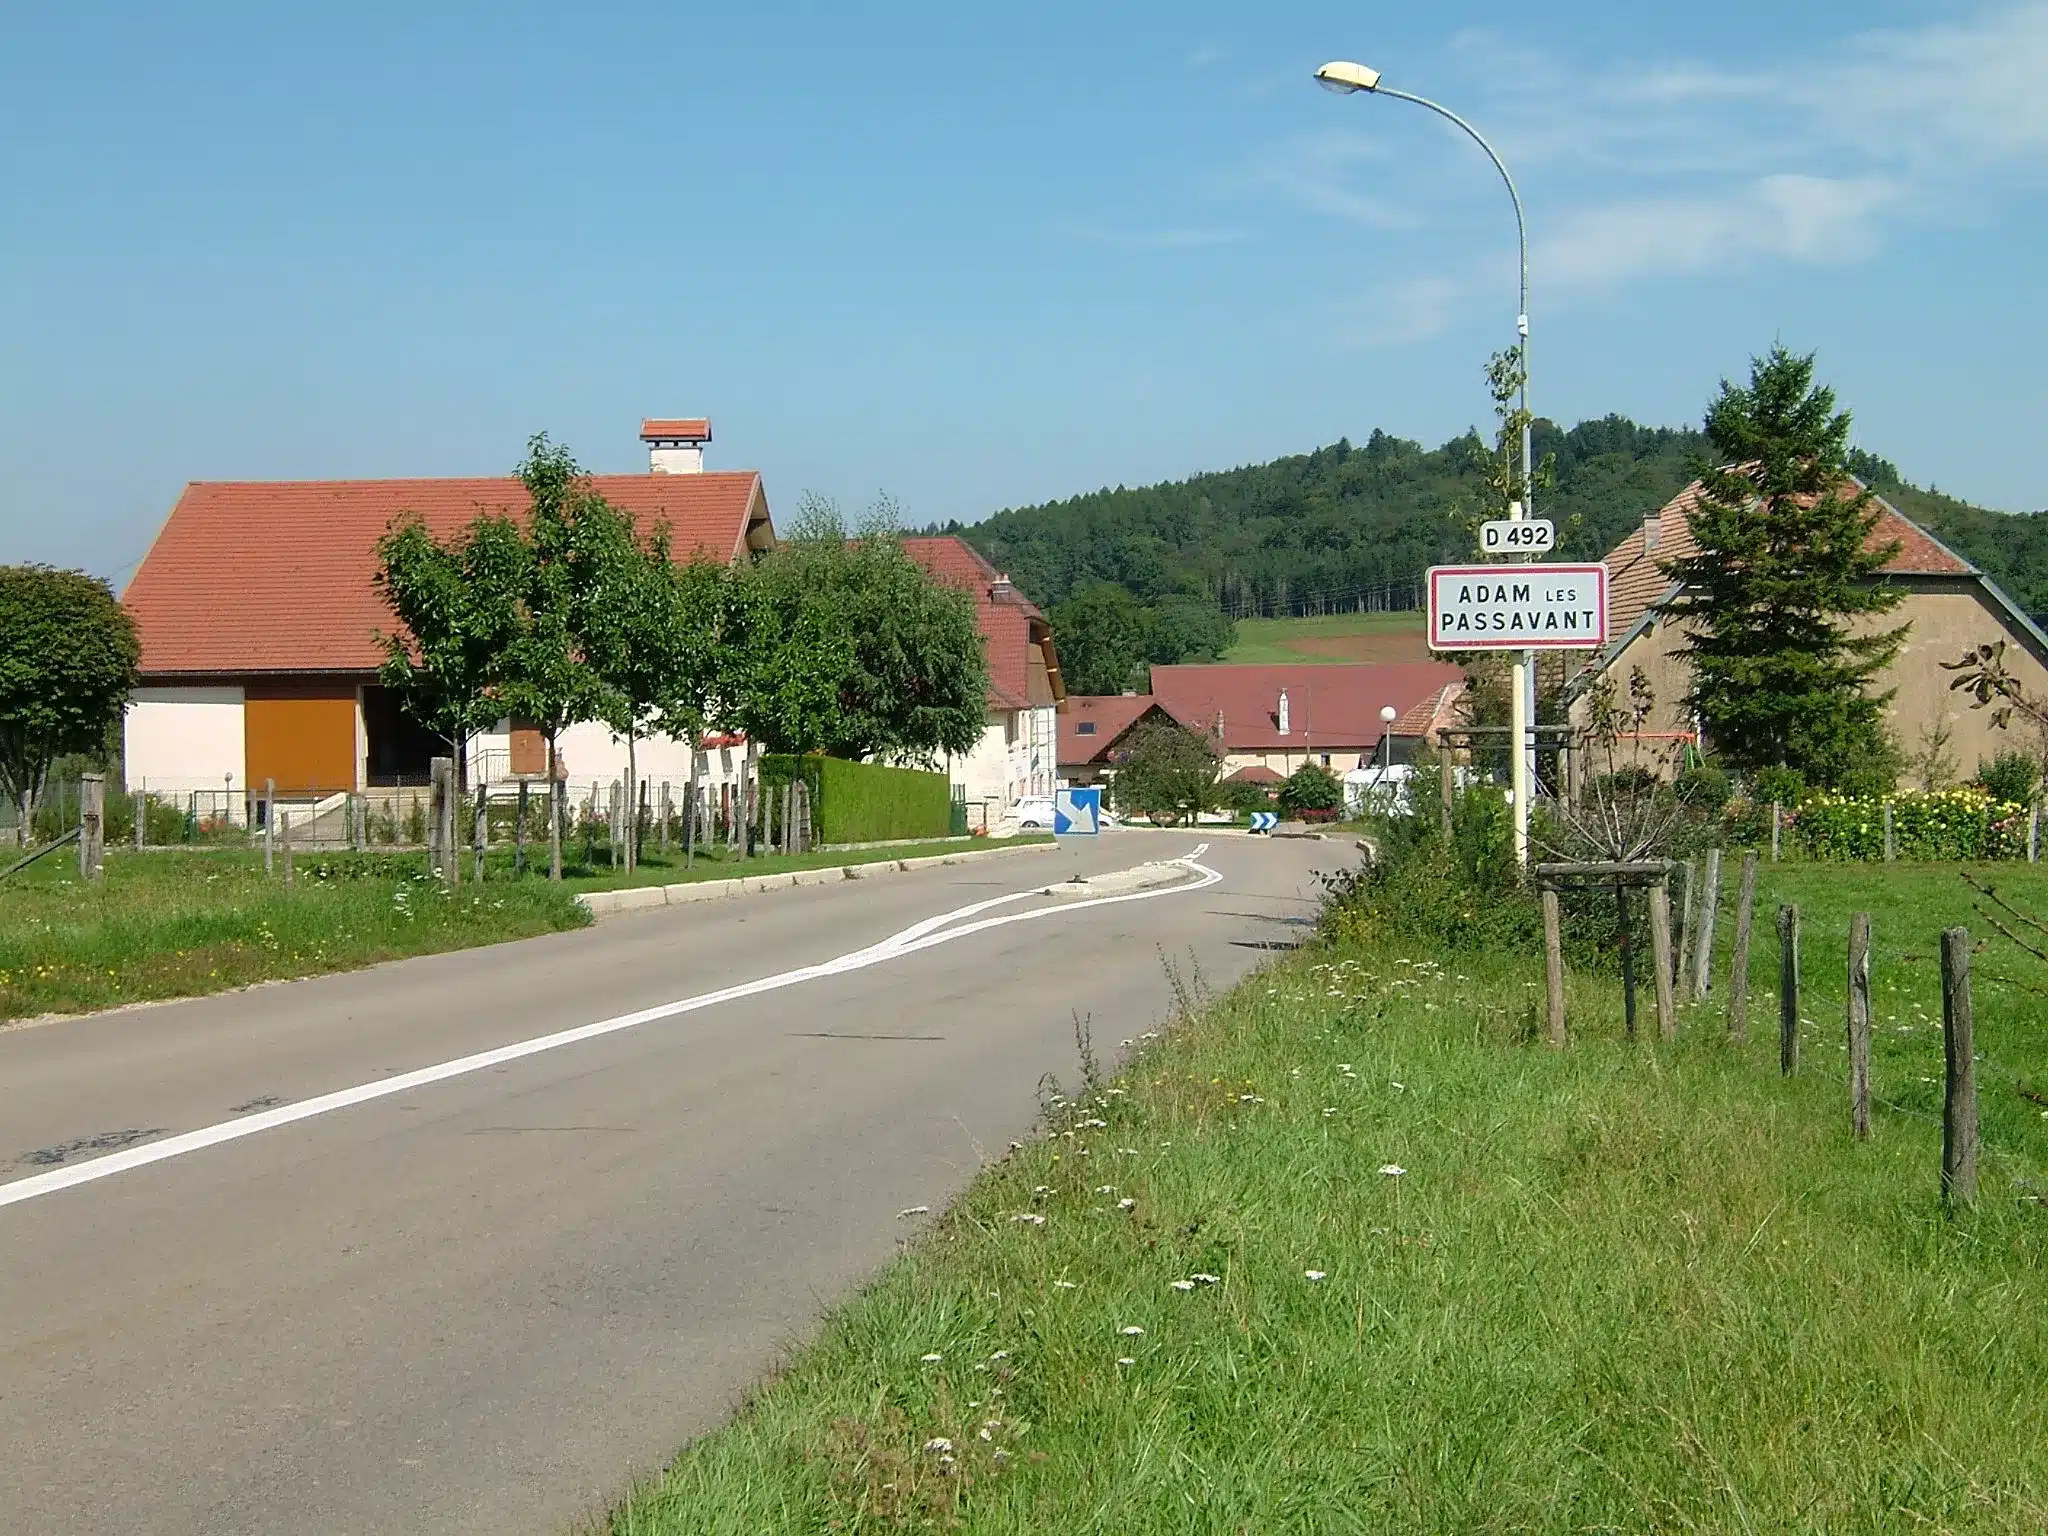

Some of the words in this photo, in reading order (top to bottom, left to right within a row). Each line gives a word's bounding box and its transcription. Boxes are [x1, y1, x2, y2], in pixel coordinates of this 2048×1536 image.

[1486, 528, 1499, 546] D
[1507, 527, 1549, 545] 492
[1458, 584, 1530, 604] ADAM
[1546, 589, 1577, 602] LES
[1441, 611, 1594, 631] PASSAVANT
